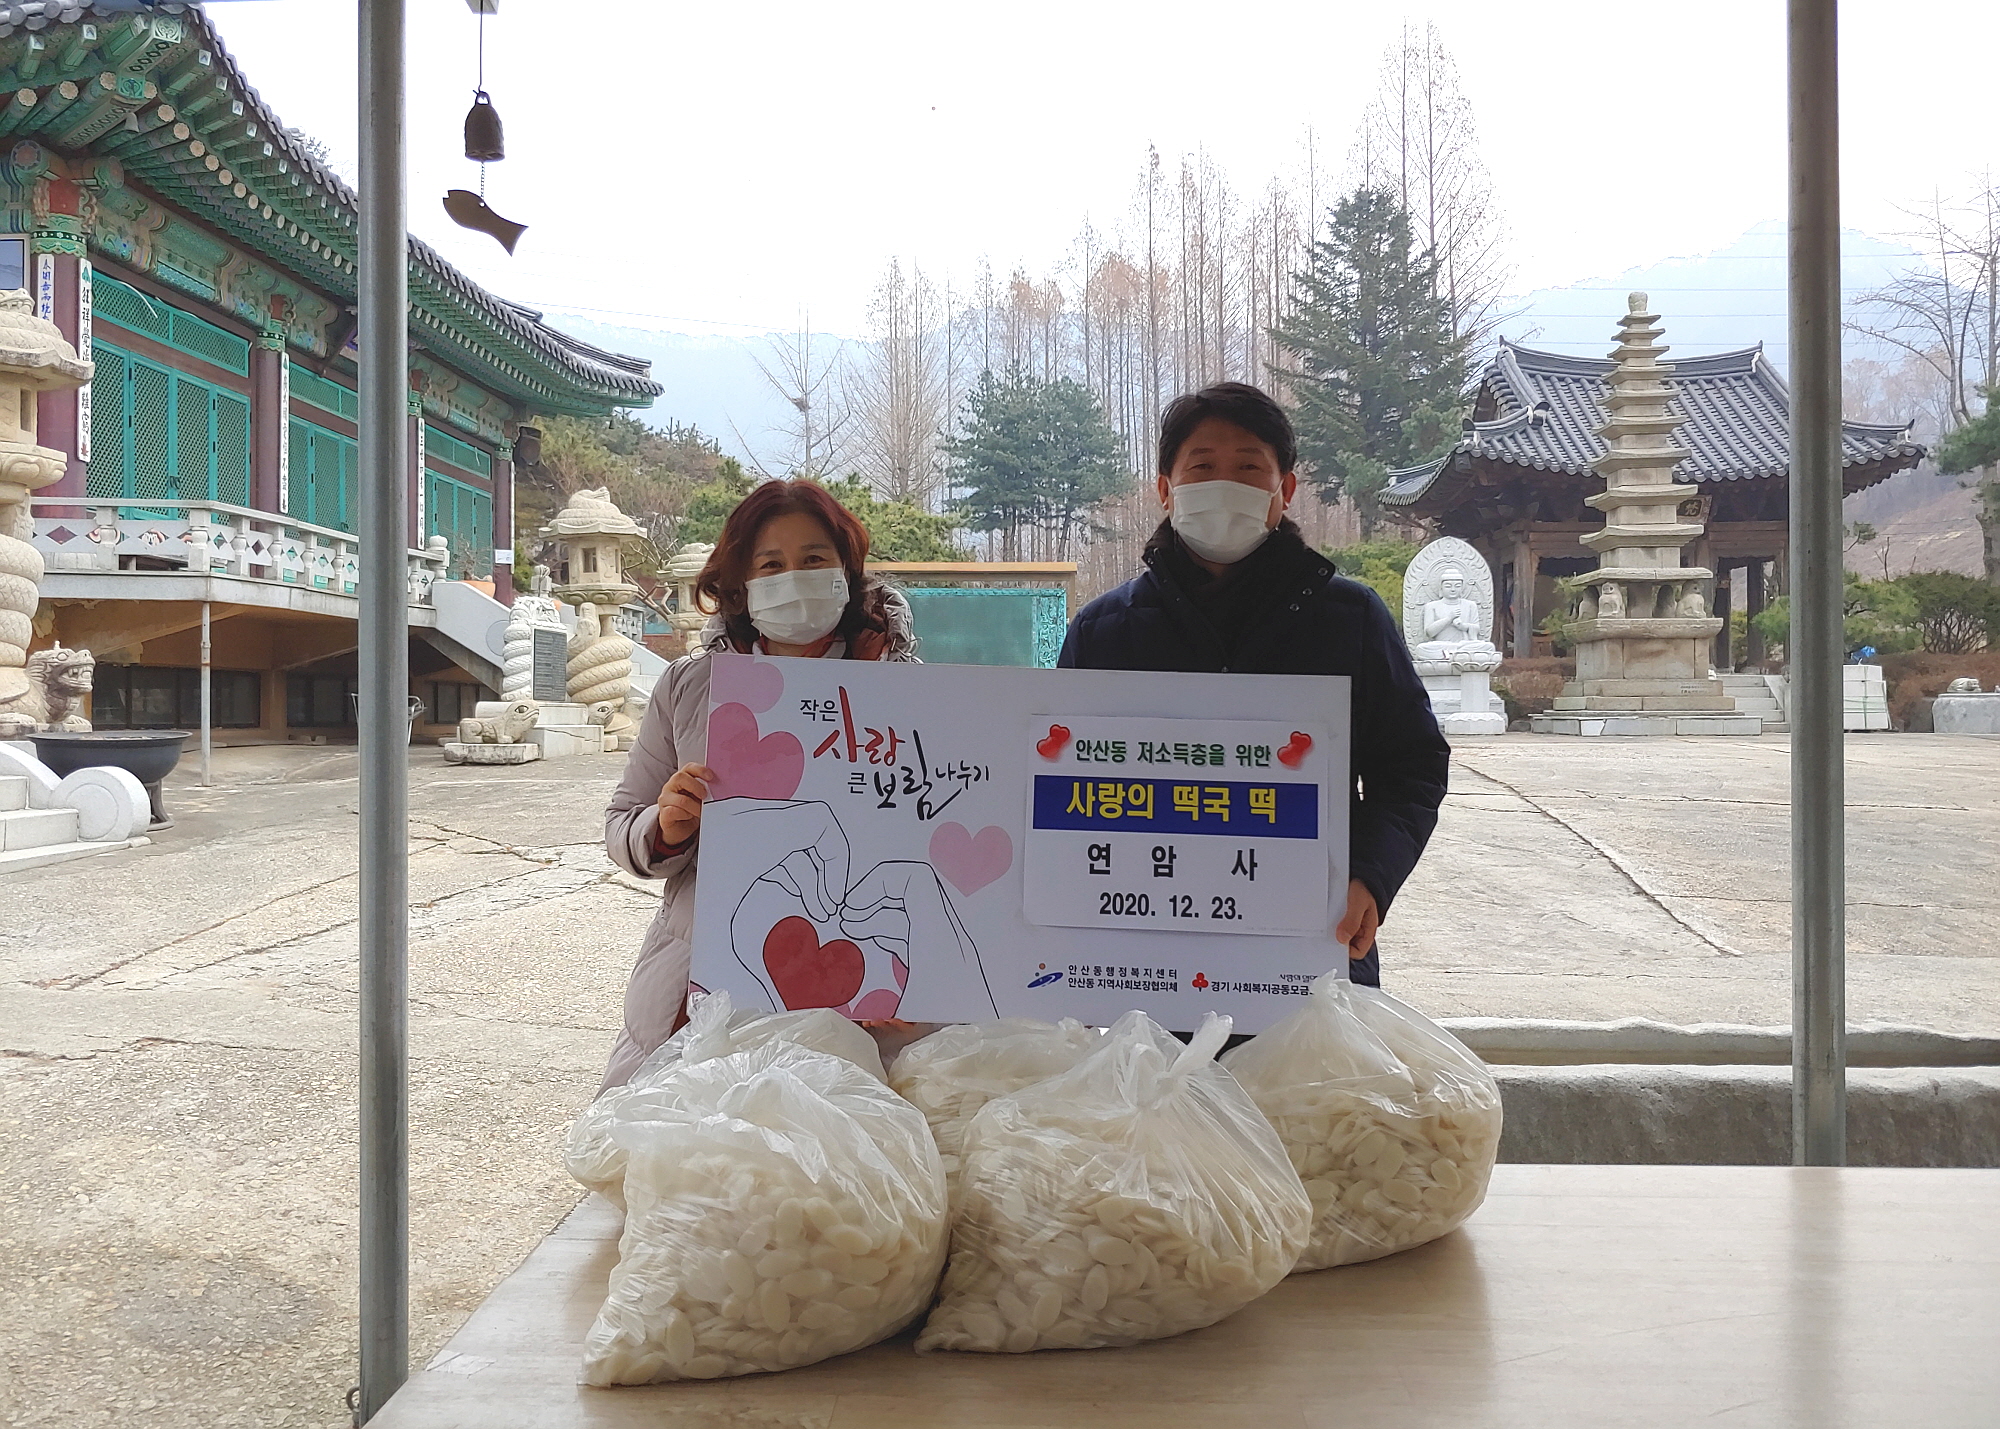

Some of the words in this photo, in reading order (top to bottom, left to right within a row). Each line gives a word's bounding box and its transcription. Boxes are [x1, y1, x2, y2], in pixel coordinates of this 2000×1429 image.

[799, 699, 839, 722] 작은
[812, 685, 906, 767] 사랑
[1075, 739, 1128, 763] 안산동
[1136, 741, 1226, 767] 저소득층을
[1235, 744, 1272, 767] 위한
[847, 772, 867, 794] 큰
[935, 760, 990, 790] 나누기
[1066, 781, 1155, 820] 사랑의
[1173, 785, 1232, 823] 떡국
[1249, 787, 1277, 825] 떡
[1099, 891, 1157, 917] 2020.
[1168, 894, 1200, 918] 12.
[1210, 896, 1243, 920] 23.
[1067, 977, 1095, 990] 안산동
[1097, 978, 1178, 993] 지역사회보장협의체
[1210, 981, 1231, 993] 경기
[1232, 982, 1315, 996] 사회복지공동모금
